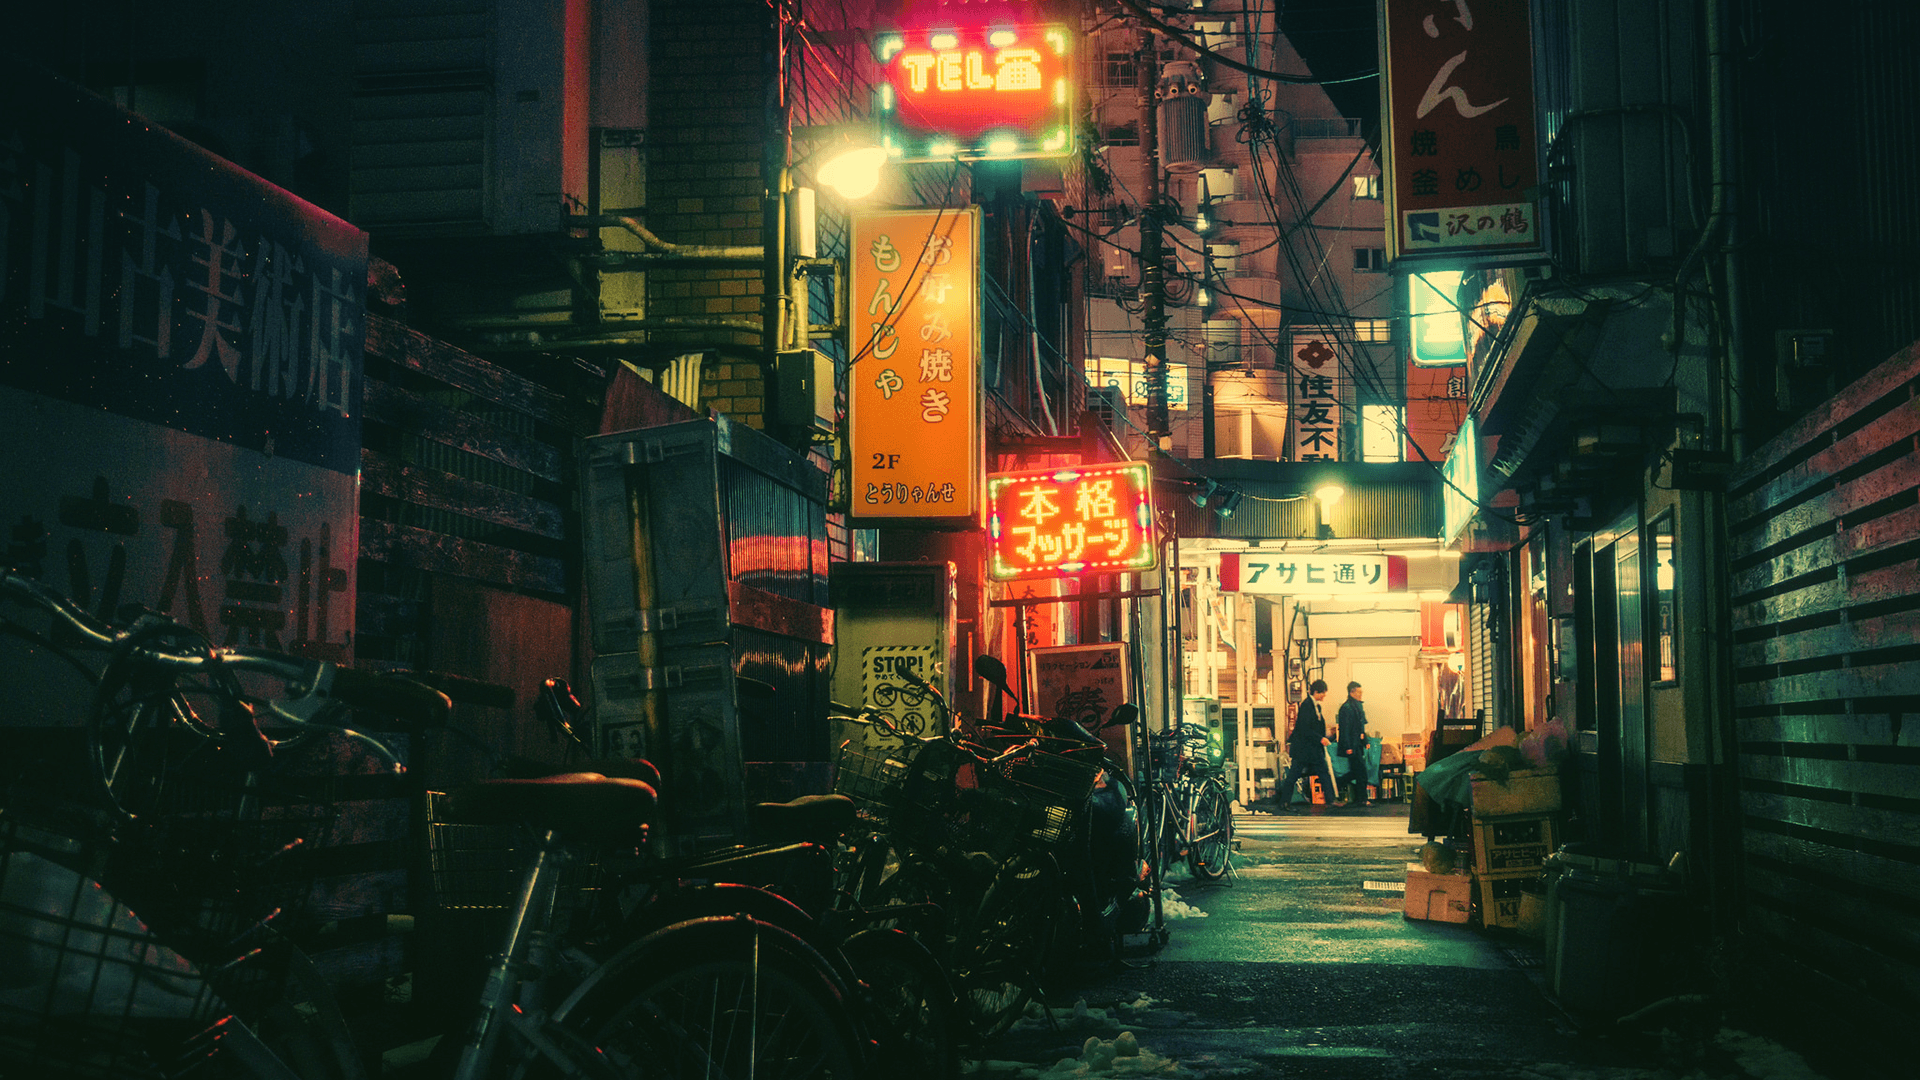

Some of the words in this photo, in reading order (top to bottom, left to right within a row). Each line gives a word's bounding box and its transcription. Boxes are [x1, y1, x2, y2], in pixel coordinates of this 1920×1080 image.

[902, 51, 994, 92] TEL
[1412, 165, 1521, 196] 釜めし
[1446, 208, 1529, 237] 沢の鶴
[868, 234, 904, 400] もんじゃ
[918, 233, 953, 424] お好み焼き
[872, 453, 901, 469] 2F
[865, 482, 956, 504] とうりゃんせ
[1019, 480, 1116, 525] 本格
[1012, 518, 1129, 563] マッサージ
[1247, 563, 1381, 585] アサヒ通り
[874, 656, 923, 673] STOP!
